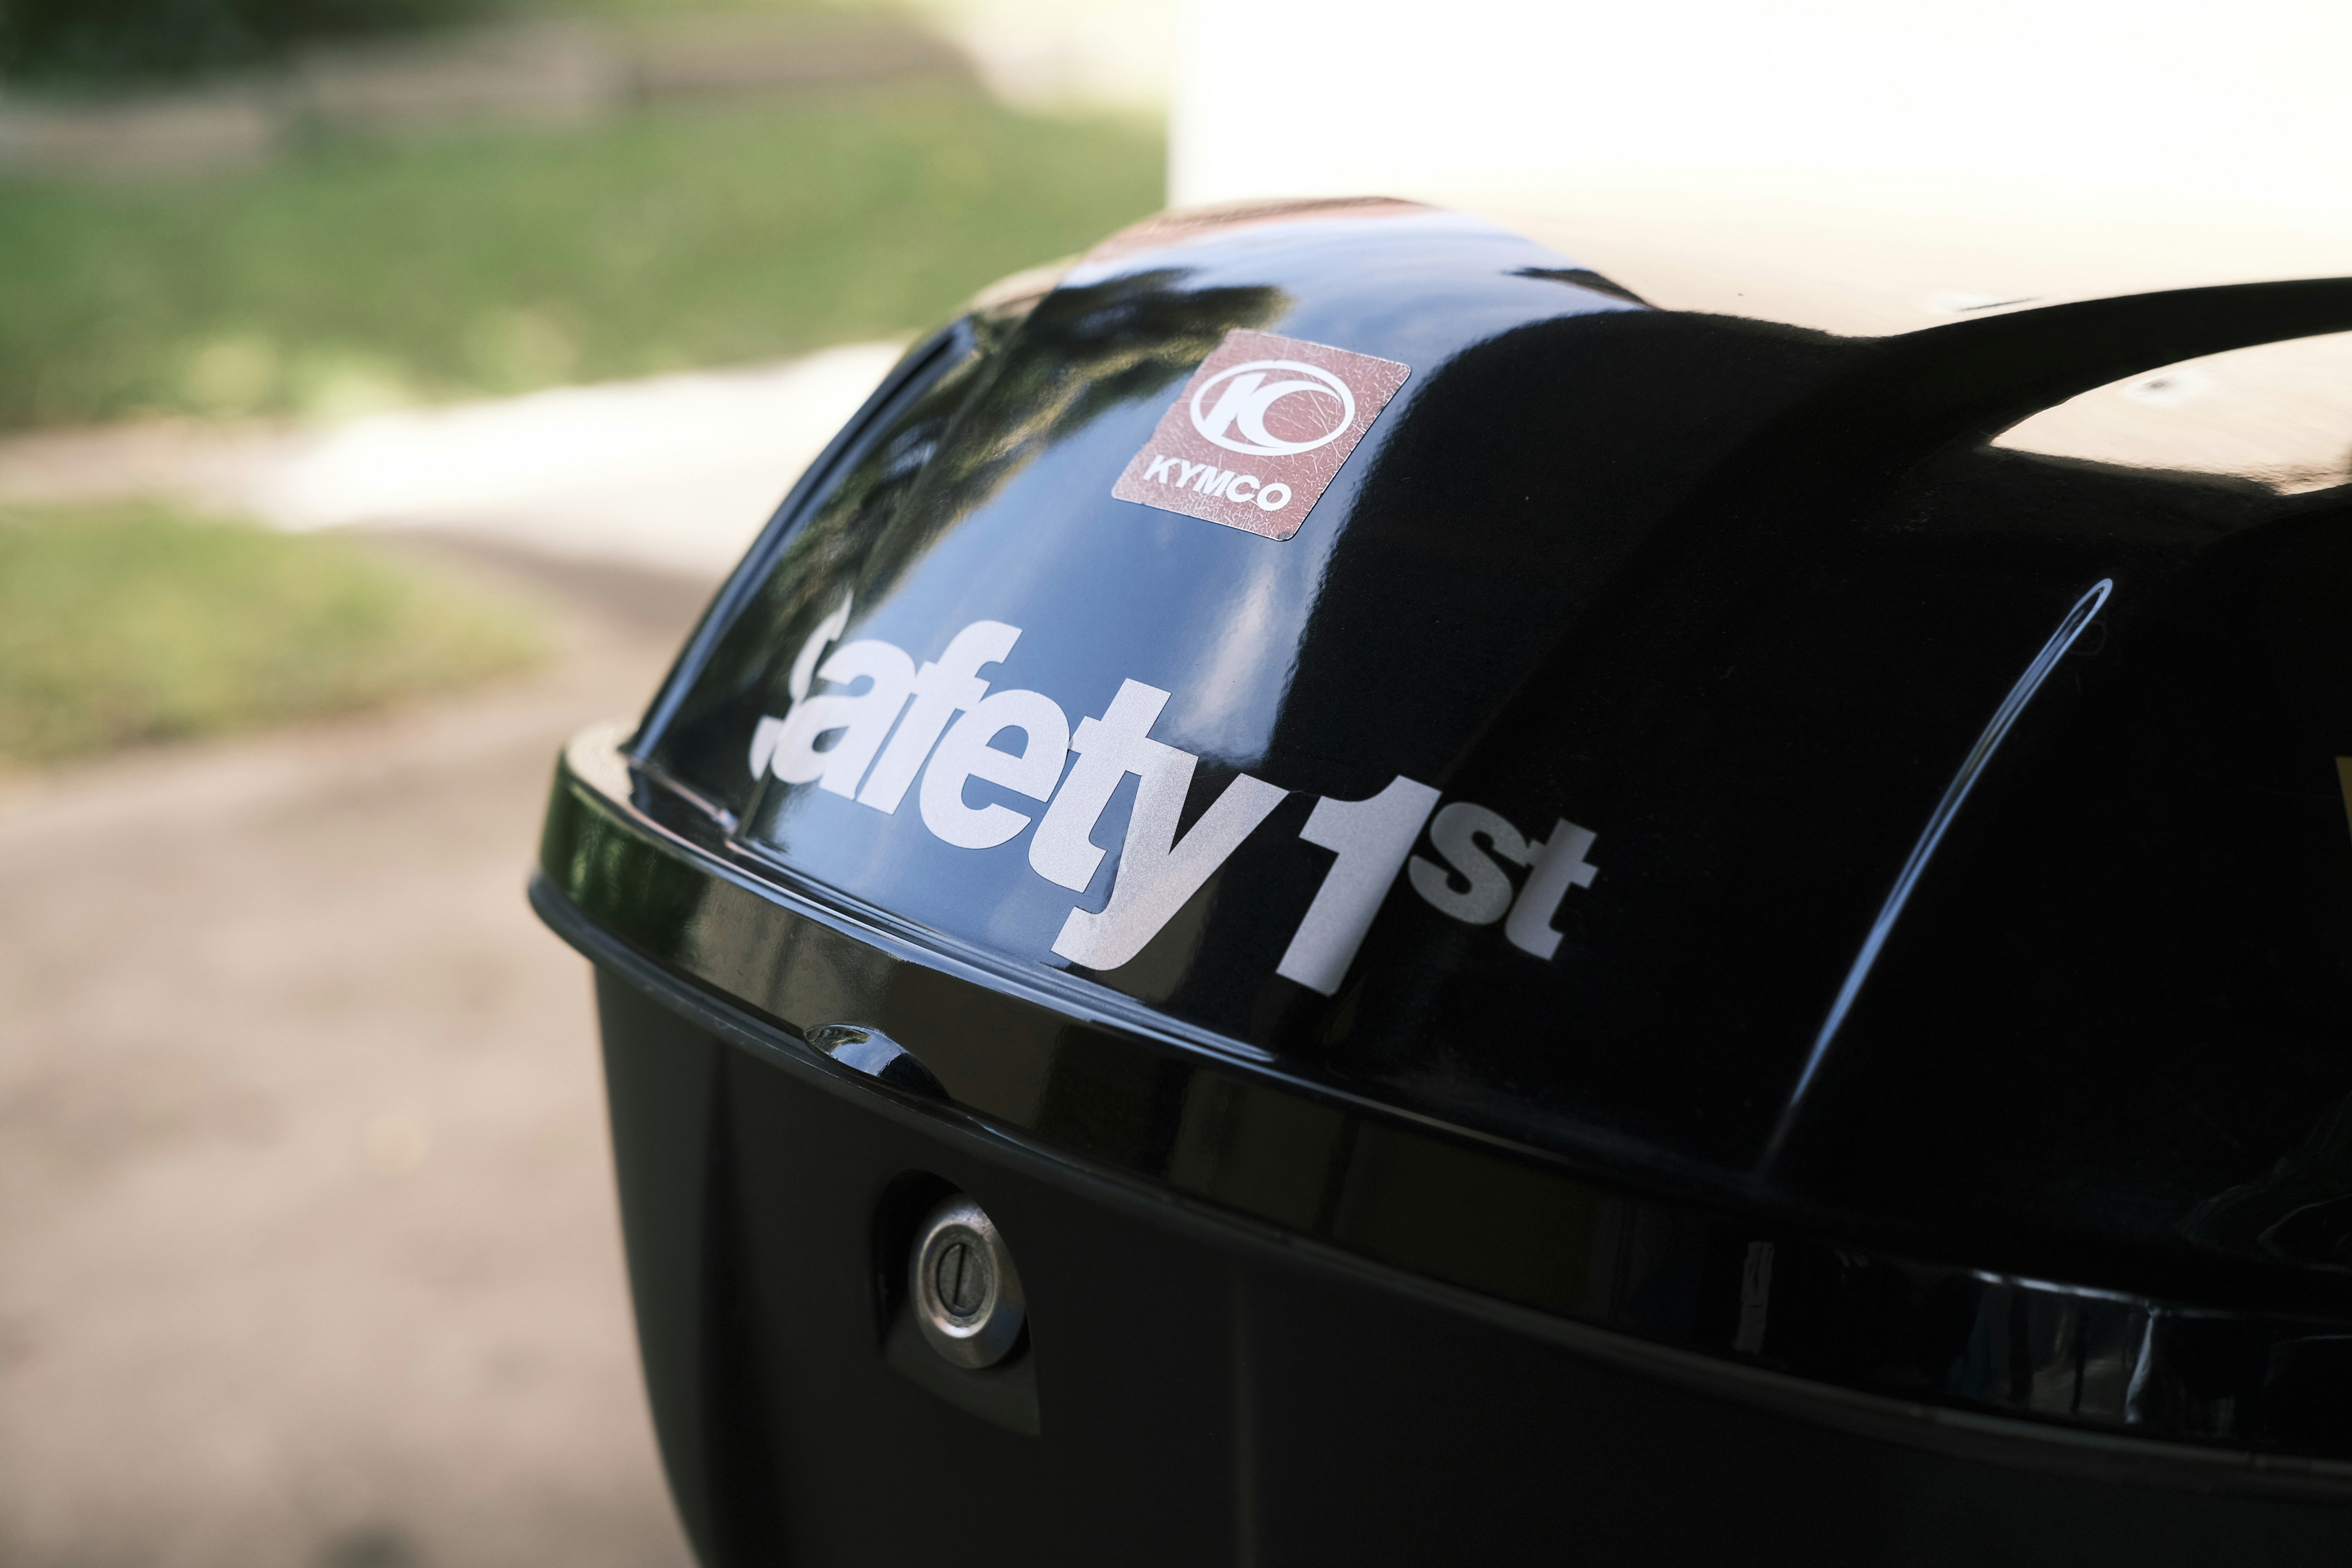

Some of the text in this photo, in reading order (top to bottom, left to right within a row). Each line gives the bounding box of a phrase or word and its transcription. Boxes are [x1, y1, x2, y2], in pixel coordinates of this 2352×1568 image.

[1143, 455, 1292, 511] KYMCO
[749, 589, 1599, 998] Safety 1st
